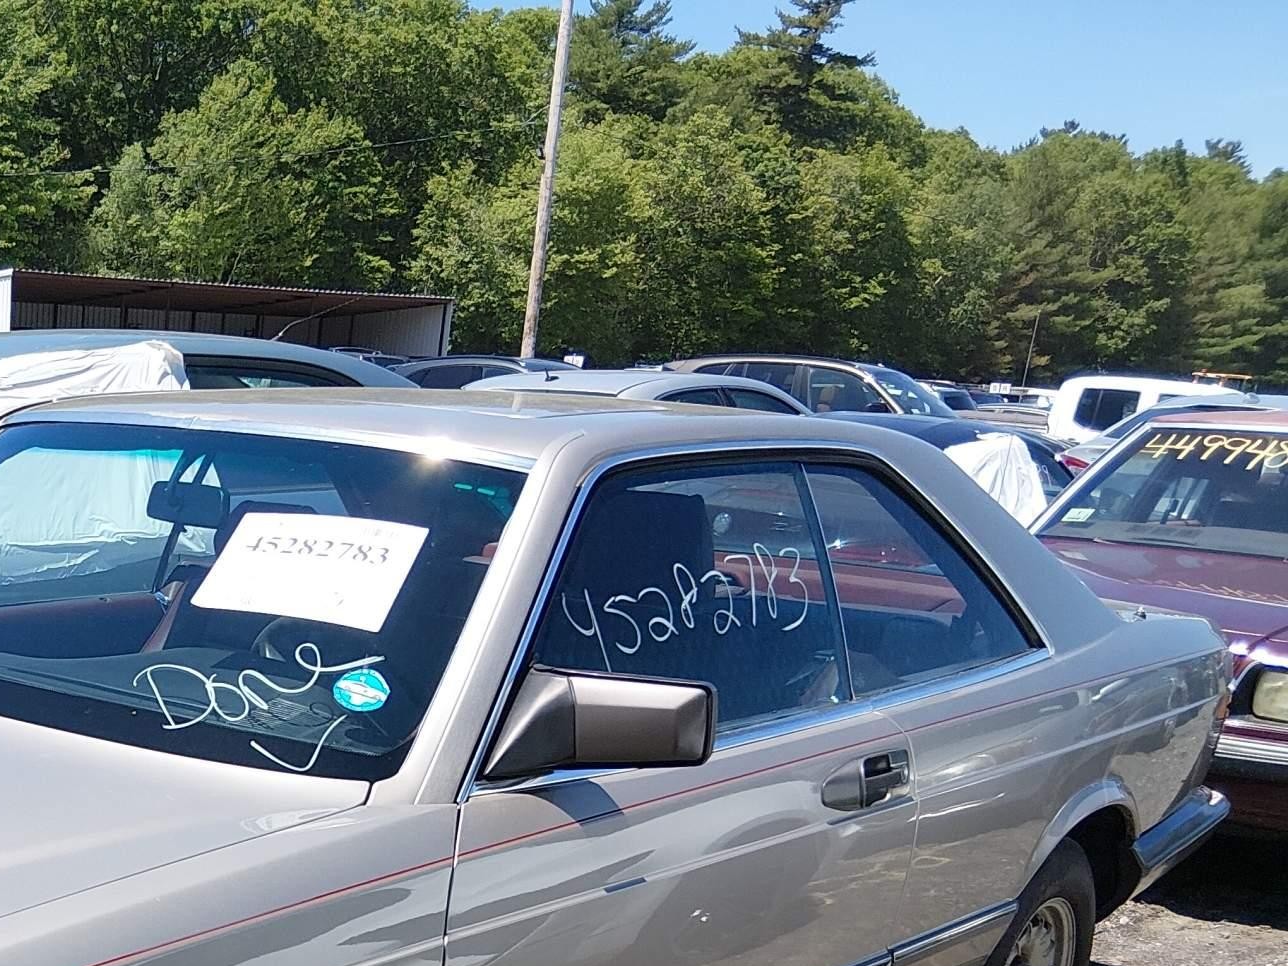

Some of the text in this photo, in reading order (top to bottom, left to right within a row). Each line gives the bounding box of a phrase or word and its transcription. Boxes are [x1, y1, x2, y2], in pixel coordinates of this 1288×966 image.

[246, 535, 390, 565] 45282783
[561, 542, 809, 673] 45282783
[133, 642, 385, 730] Done
